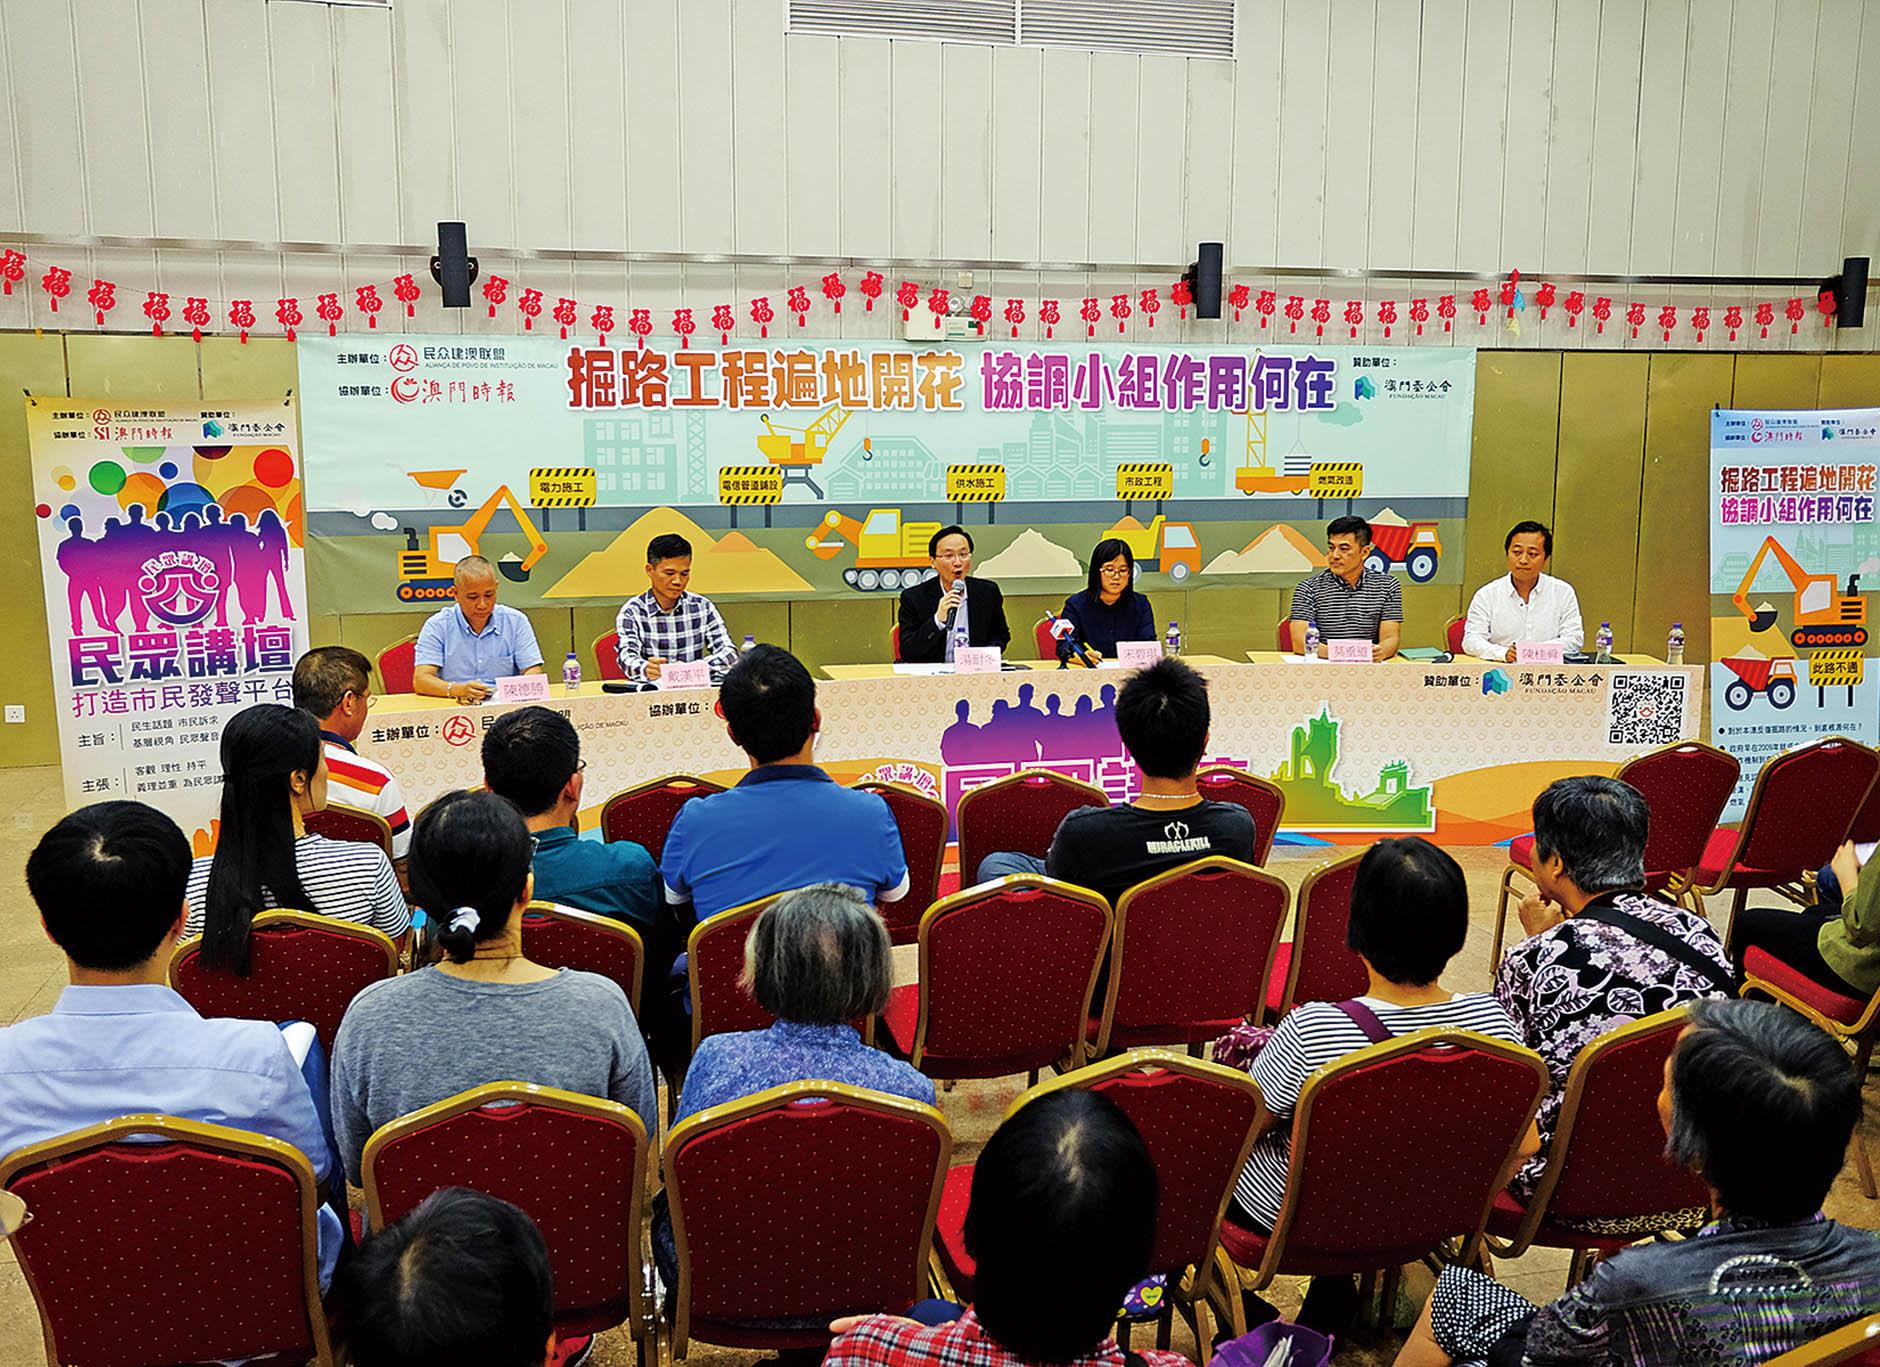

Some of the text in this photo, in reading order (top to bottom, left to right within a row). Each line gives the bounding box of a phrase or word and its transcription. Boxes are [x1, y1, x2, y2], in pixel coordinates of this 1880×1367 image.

[42, 266, 71, 297] 福
[394, 274, 420, 303] 福
[483, 275, 508, 303] 福
[822, 273, 846, 299] 福
[860, 272, 883, 299] 福
[88, 279, 116, 310] 福
[356, 285, 382, 313] 福
[519, 288, 542, 317] 福
[788, 286, 811, 313] 福
[897, 281, 919, 307] 福
[928, 288, 949, 313] 福
[1111, 294, 1131, 318] 福
[1140, 289, 1160, 312] 福
[1229, 285, 1250, 309] 福
[1256, 290, 1276, 315] 福
[1472, 289, 1492, 311] 福
[1536, 283, 1556, 307] 福
[1564, 291, 1584, 315] 福
[144, 292, 170, 321] 福
[183, 297, 210, 326] 福
[229, 301, 256, 327] 福
[275, 298, 302, 326] 福
[316, 293, 343, 323] 福
[553, 298, 576, 326] 福
[712, 305, 735, 331] 福
[752, 298, 774, 323] 福
[971, 296, 992, 321] 福
[1005, 300, 1025, 324] 福
[1040, 300, 1060, 324] 福
[1081, 298, 1101, 322] 福
[1285, 296, 1304, 320] 福
[1312, 299, 1331, 323] 福
[1344, 301, 1363, 324] 福
[1379, 301, 1397, 323] 福
[1410, 299, 1429, 322] 福
[1438, 295, 1456, 318] 福
[1594, 297, 1611, 320] 福
[1628, 303, 1645, 325] 福
[1659, 306, 1677, 328] 福
[1692, 307, 1710, 328] 福
[1724, 306, 1743, 328] 福
[1756, 304, 1774, 325] 福
[1786, 298, 1804, 320] 福
[592, 306, 614, 332] 福
[629, 309, 653, 334] 福
[672, 309, 696, 334] 福
[337, 353, 387, 364] 主辦單位：
[423, 346, 505, 361] 民众建澳联盟
[338, 386, 389, 396] 協辦單位：
[422, 379, 516, 404] 澳門時報
[568, 348, 964, 411] 掘路工程遍地開花
[981, 352, 1336, 410] 協調小組作用何在
[540, 482, 584, 493] 電力施工
[956, 478, 995, 488] 供水施工
[1125, 477, 1162, 486] 市政工程
[1721, 465, 1876, 493] 掘路工程遍地開花
[1721, 496, 1873, 524] 協調小組作用何在
[68, 625, 294, 688] 民眾講壇
[1813, 662, 1857, 674] 此路不通
[72, 678, 293, 717] 打造市民發聲平台
[648, 702, 708, 717] 協辦單位：
[78, 732, 115, 748] 主旨：
[372, 725, 439, 743] 主辦單位：
[161, 762, 181, 773] 理性
[82, 777, 119, 793] 主張：
